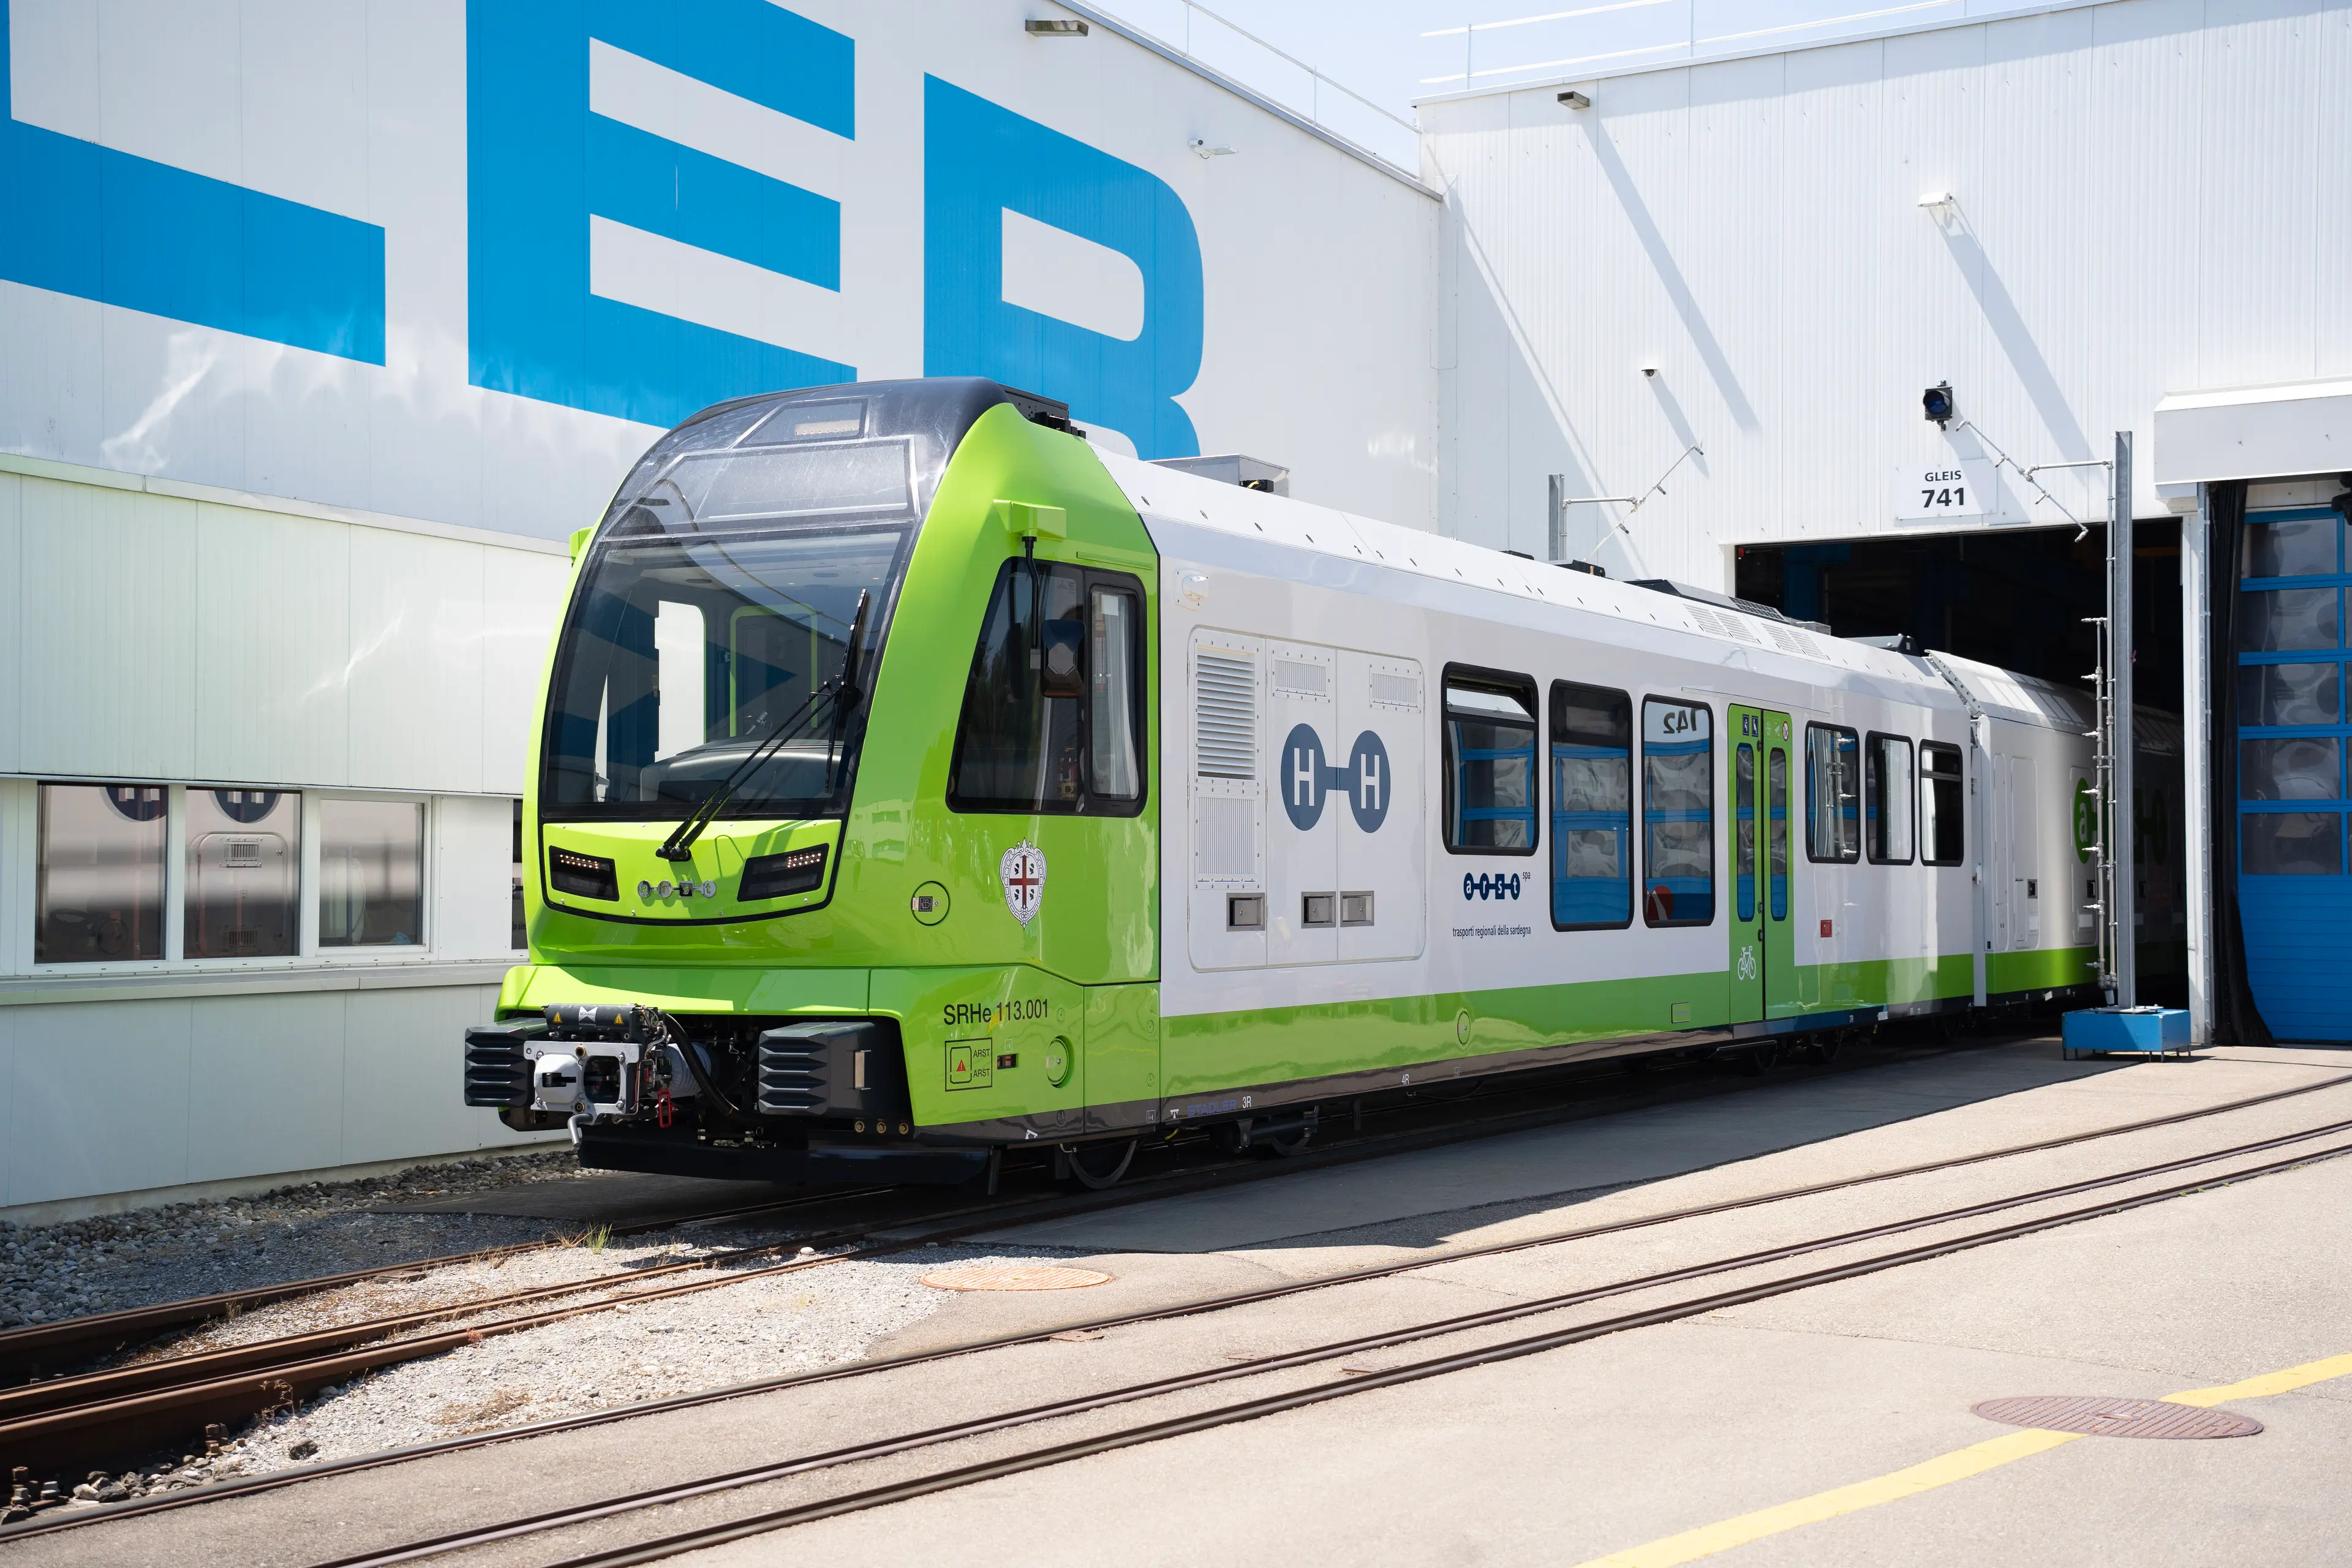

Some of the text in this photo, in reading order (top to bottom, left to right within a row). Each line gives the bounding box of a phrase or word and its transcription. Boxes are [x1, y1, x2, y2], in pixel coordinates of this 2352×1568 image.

[1924, 470, 1961, 482] GLEIS
[1921, 488, 1964, 508] 741
[640, 881, 712, 895] arst
[1466, 877, 1517, 894] arst
[1452, 924, 1531, 939] trasporti regionali della sardegna
[943, 998, 1048, 1025] SRHe 113.001
[973, 1048, 990, 1058] ARST
[973, 1068, 990, 1078] ARST
[1401, 1074, 1409, 1085] 4R
[1187, 1095, 1251, 1117] STADLER 3R
